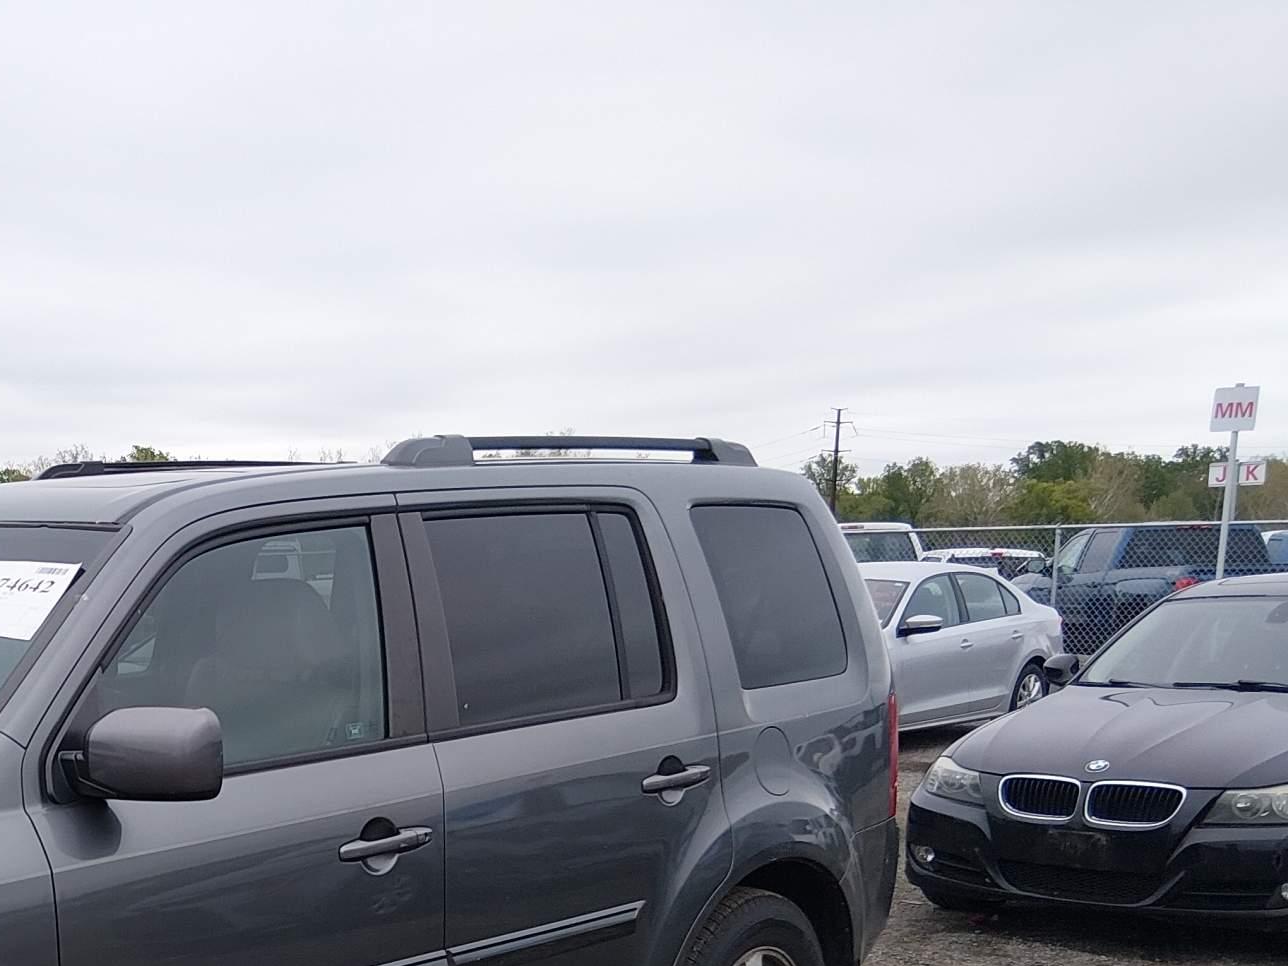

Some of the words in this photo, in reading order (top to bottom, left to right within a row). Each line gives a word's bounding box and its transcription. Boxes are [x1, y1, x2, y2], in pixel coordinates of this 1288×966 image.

[1214, 401, 1254, 418] MM
[1215, 464, 1227, 483] J
[1245, 464, 1260, 481] K
